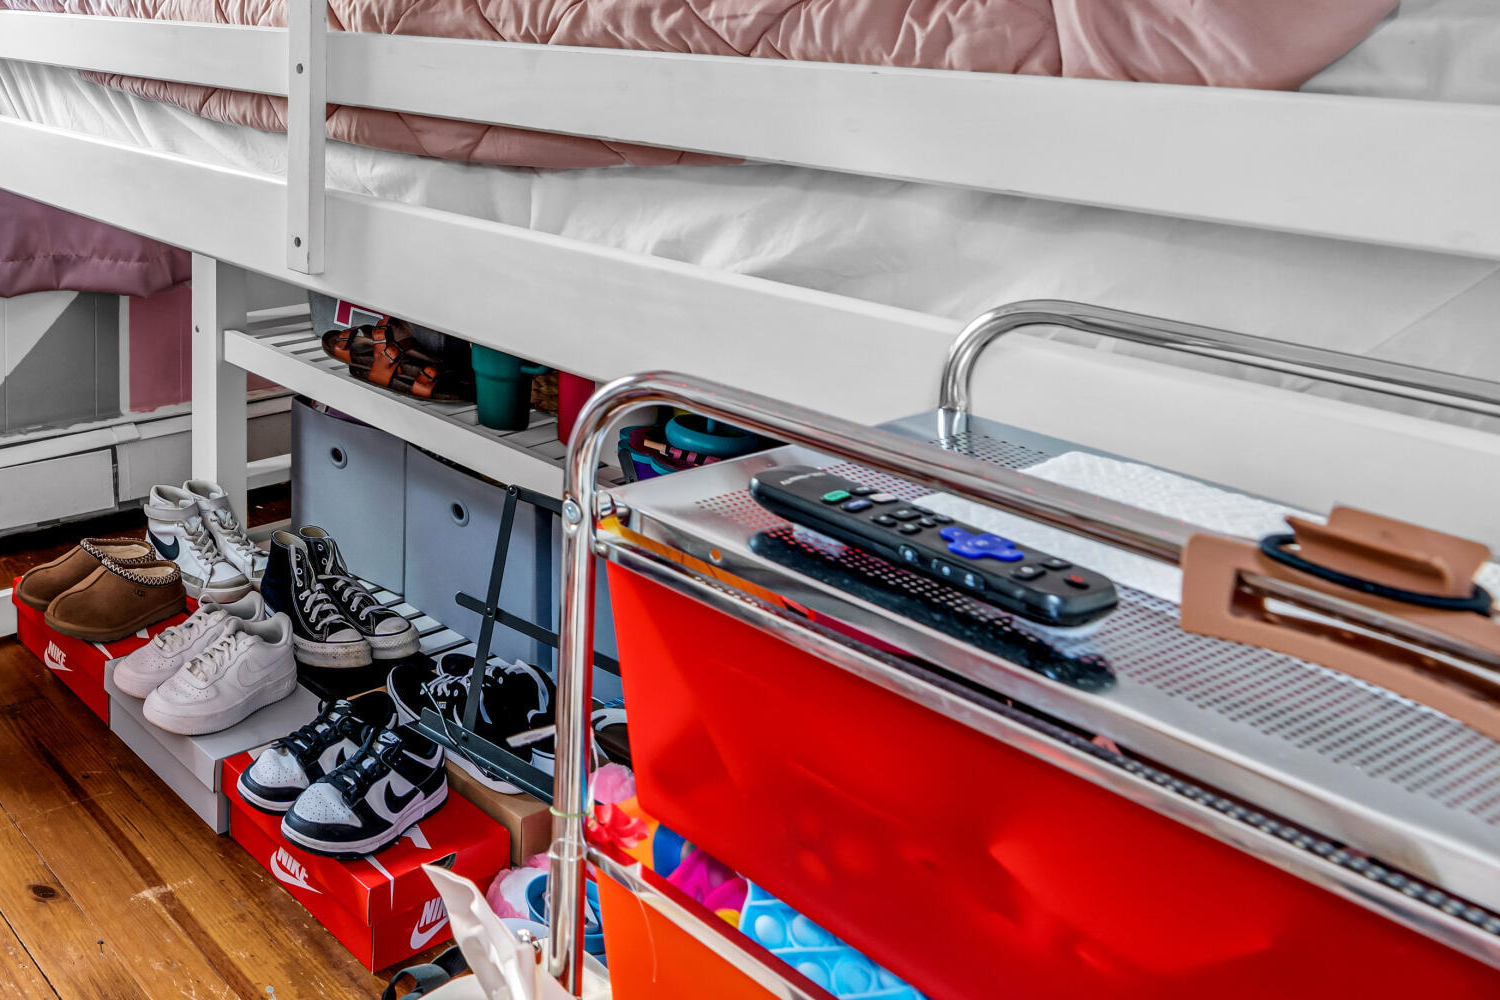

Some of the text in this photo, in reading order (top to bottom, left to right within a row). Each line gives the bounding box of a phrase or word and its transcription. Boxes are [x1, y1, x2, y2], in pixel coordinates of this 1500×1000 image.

[47, 639, 67, 666] NIKE
[276, 845, 309, 884] NIKE
[419, 896, 449, 928] NIK
